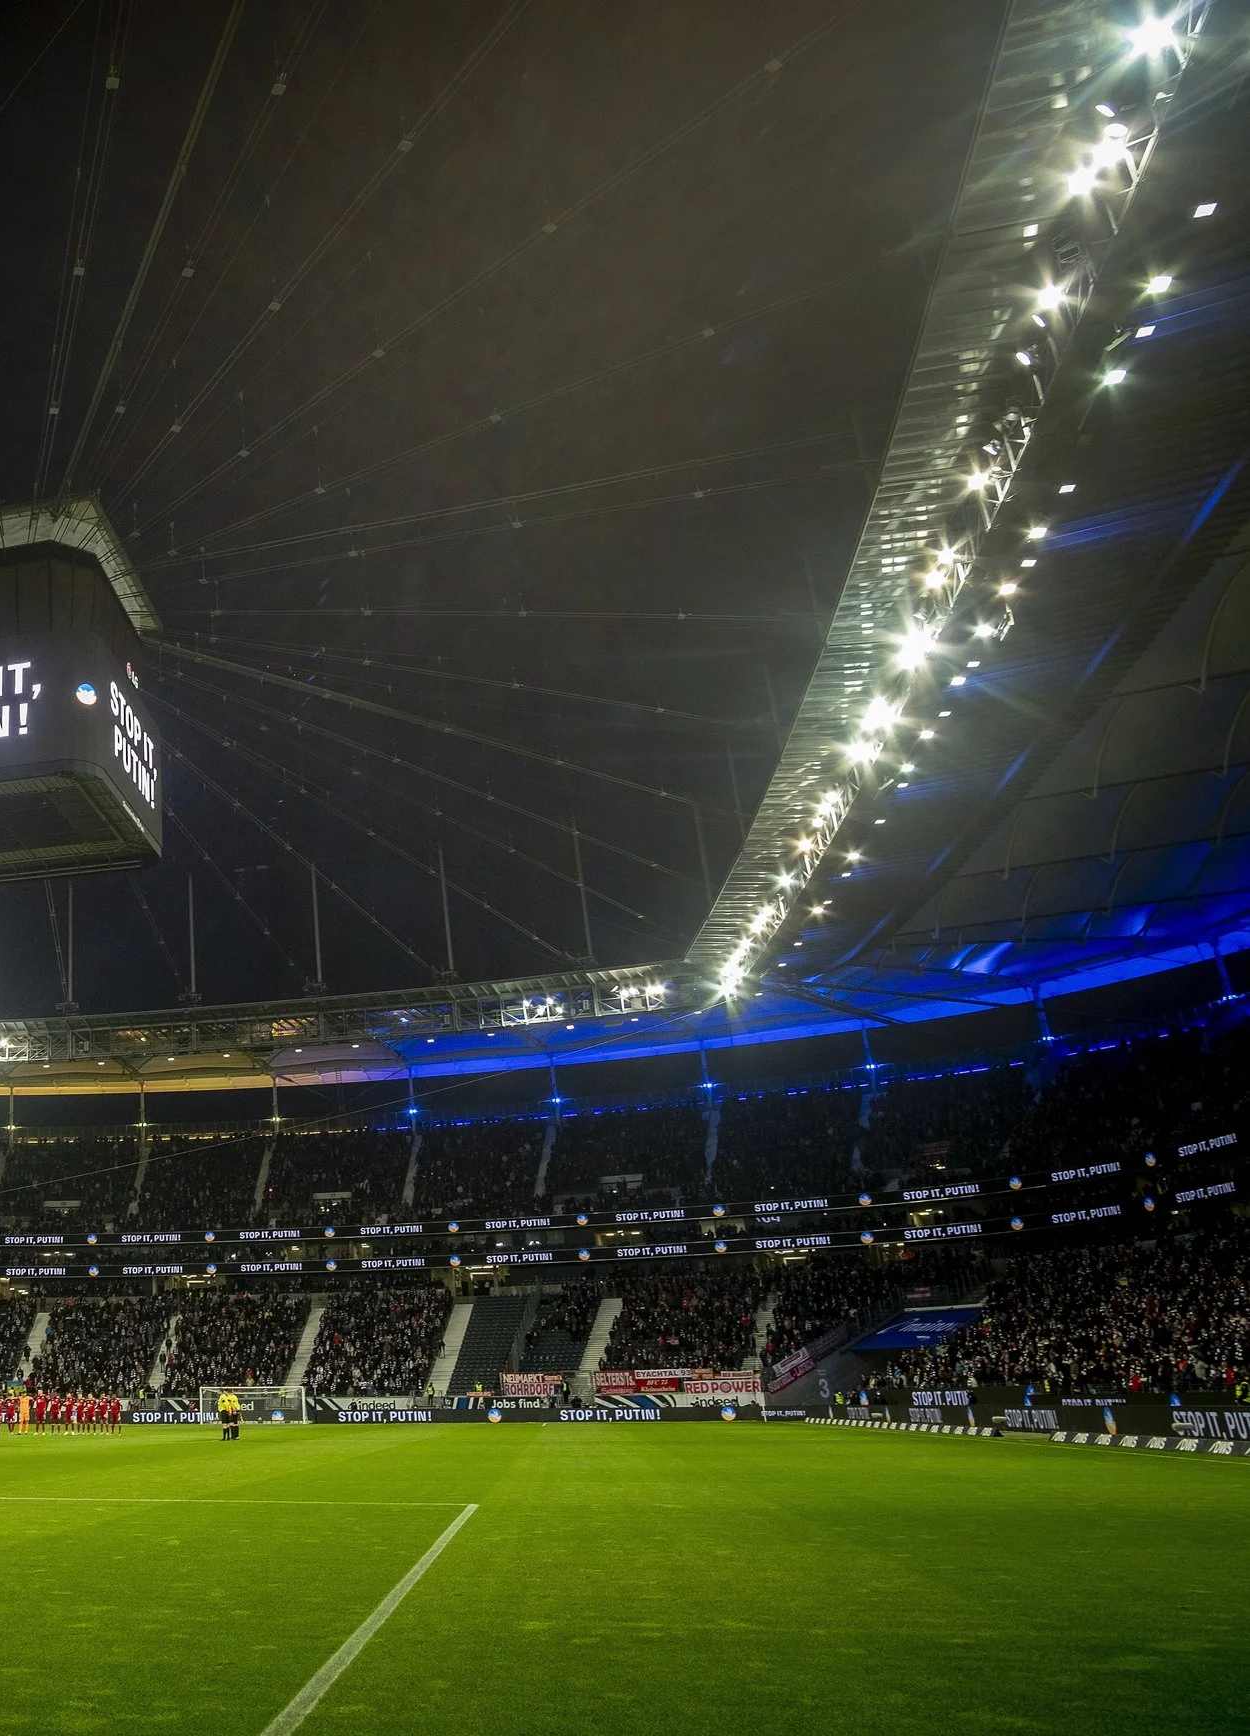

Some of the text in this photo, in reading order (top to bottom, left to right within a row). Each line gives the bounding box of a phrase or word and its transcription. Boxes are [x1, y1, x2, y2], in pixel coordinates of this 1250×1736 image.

[132, 671, 139, 689] LG
[110, 681, 158, 782] STOP IT,
[114, 724, 155, 810] PUTIN!
[1178, 1133, 1237, 1156] STOP IT, PUTIN!
[1051, 1162, 1120, 1181] STOP IT, PUTIN!
[903, 1184, 979, 1200] STOP IT, PUTIN!
[1176, 1182, 1235, 1203] STOP IT, PUTIN!
[754, 1199, 828, 1212] STOP IT, PUTIN!
[616, 1210, 685, 1221] STOP IT, PUTIN!
[1052, 1205, 1121, 1223] STOP IT, PUTIN!
[360, 1225, 422, 1235] STOP IT, PUTIN!
[485, 1218, 550, 1229] STOP IT, PUTIN!
[904, 1224, 982, 1239] STOP IT, PUTIN!
[143, 1235, 153, 1243] IT,
[154, 1234, 181, 1242] PUTIN!
[756, 1236, 830, 1248] STOP IT, PUTIN!
[617, 1245, 687, 1257] STOP IT, PUTIN!
[486, 1253, 552, 1263] STOP IT, PUTIN!
[6, 1268, 26, 1276] STOP
[28, 1268, 37, 1276] IT,
[241, 1264, 262, 1272] STOP
[263, 1264, 273, 1272] IT,
[503, 1374, 544, 1383] NEUMARKT
[505, 1384, 554, 1395] ROHRDORF
[685, 1381, 760, 1394] RED POWER
[819, 1379, 829, 1398] 3
[357, 1398, 395, 1410] indeed
[492, 1399, 540, 1408] Jobs find
[912, 1392, 933, 1406] STOP
[133, 1413, 162, 1422] STOP
[164, 1413, 177, 1424] IT,
[338, 1411, 432, 1423] STOP IT, PUTIN!
[560, 1409, 660, 1422] STOP IT, PUTIN!
[1004, 1409, 1022, 1427] STOP
[1033, 1410, 1059, 1429] PUTIN!
[1173, 1411, 1205, 1436] STOP
[1206, 1412, 1227, 1440] IT,
